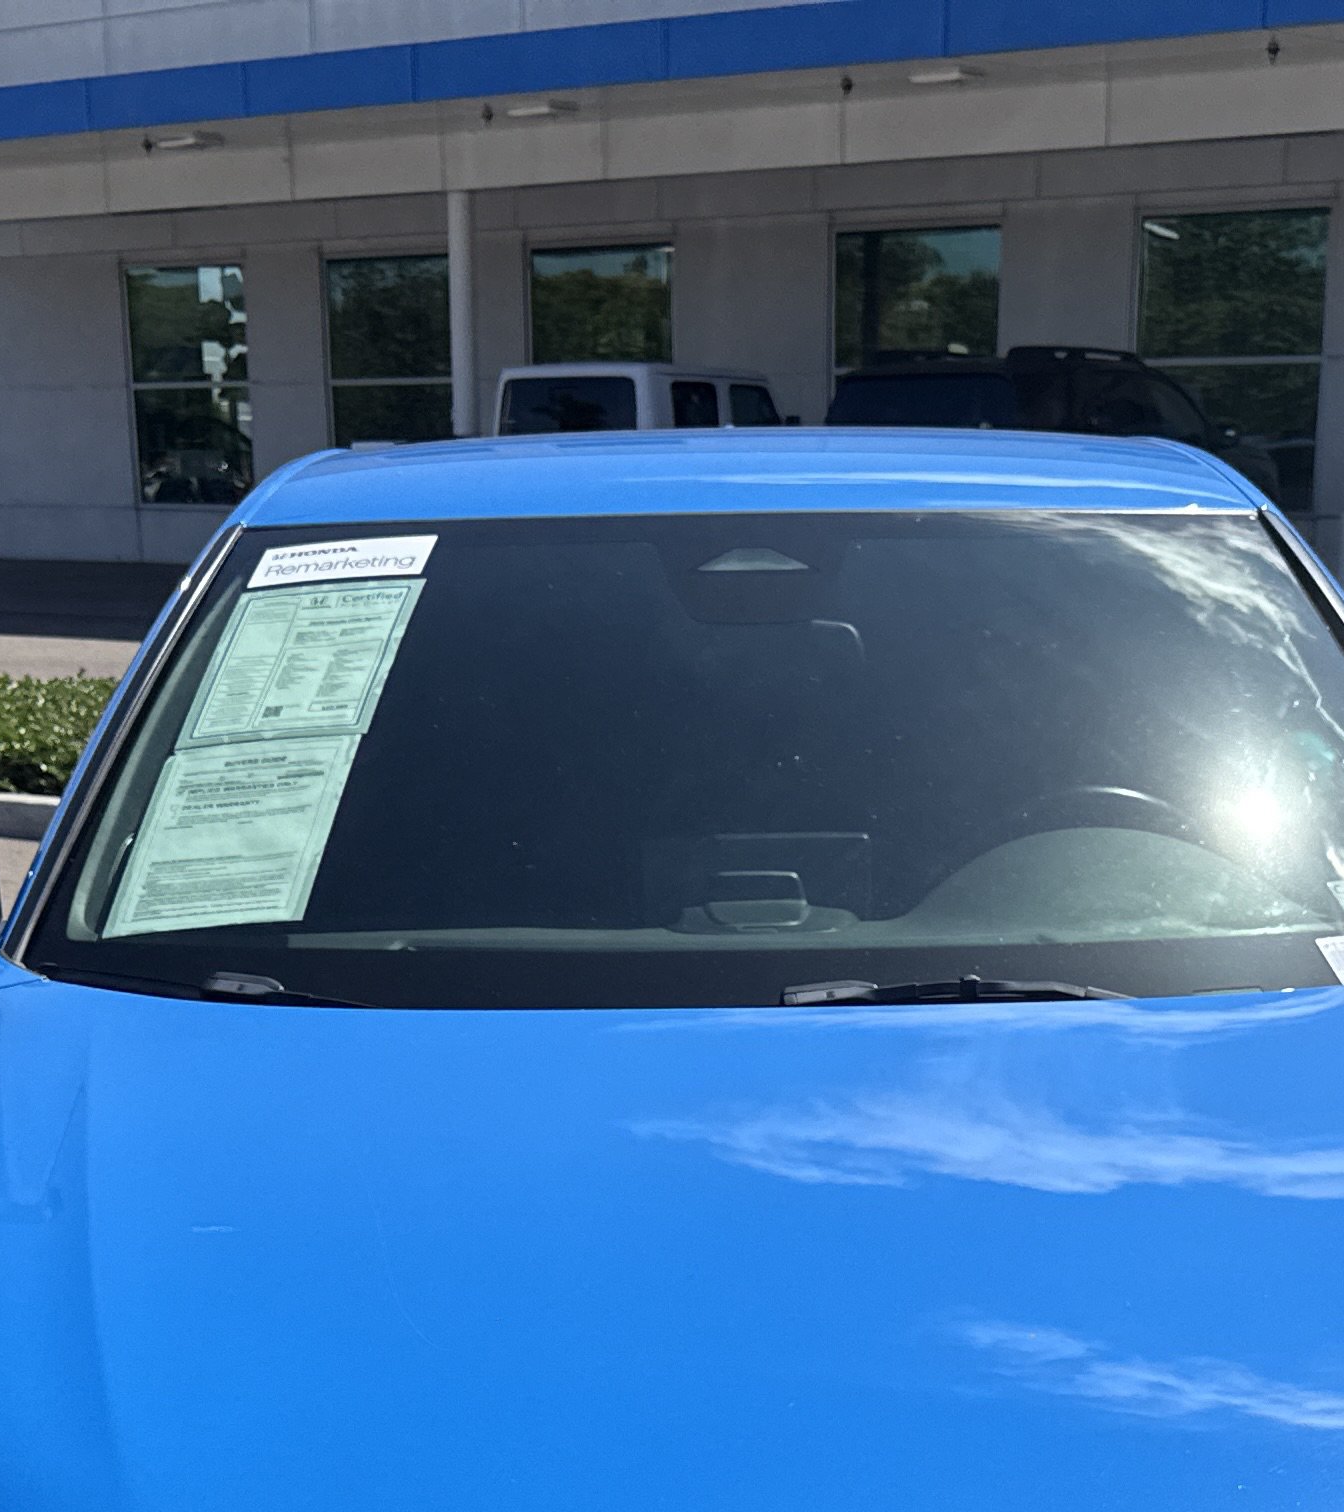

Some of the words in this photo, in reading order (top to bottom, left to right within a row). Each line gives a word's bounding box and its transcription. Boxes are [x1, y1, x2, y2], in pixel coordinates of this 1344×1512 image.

[289, 546, 359, 559] HONDA
[264, 556, 416, 577] Remarketing
[342, 591, 404, 603] Certified
